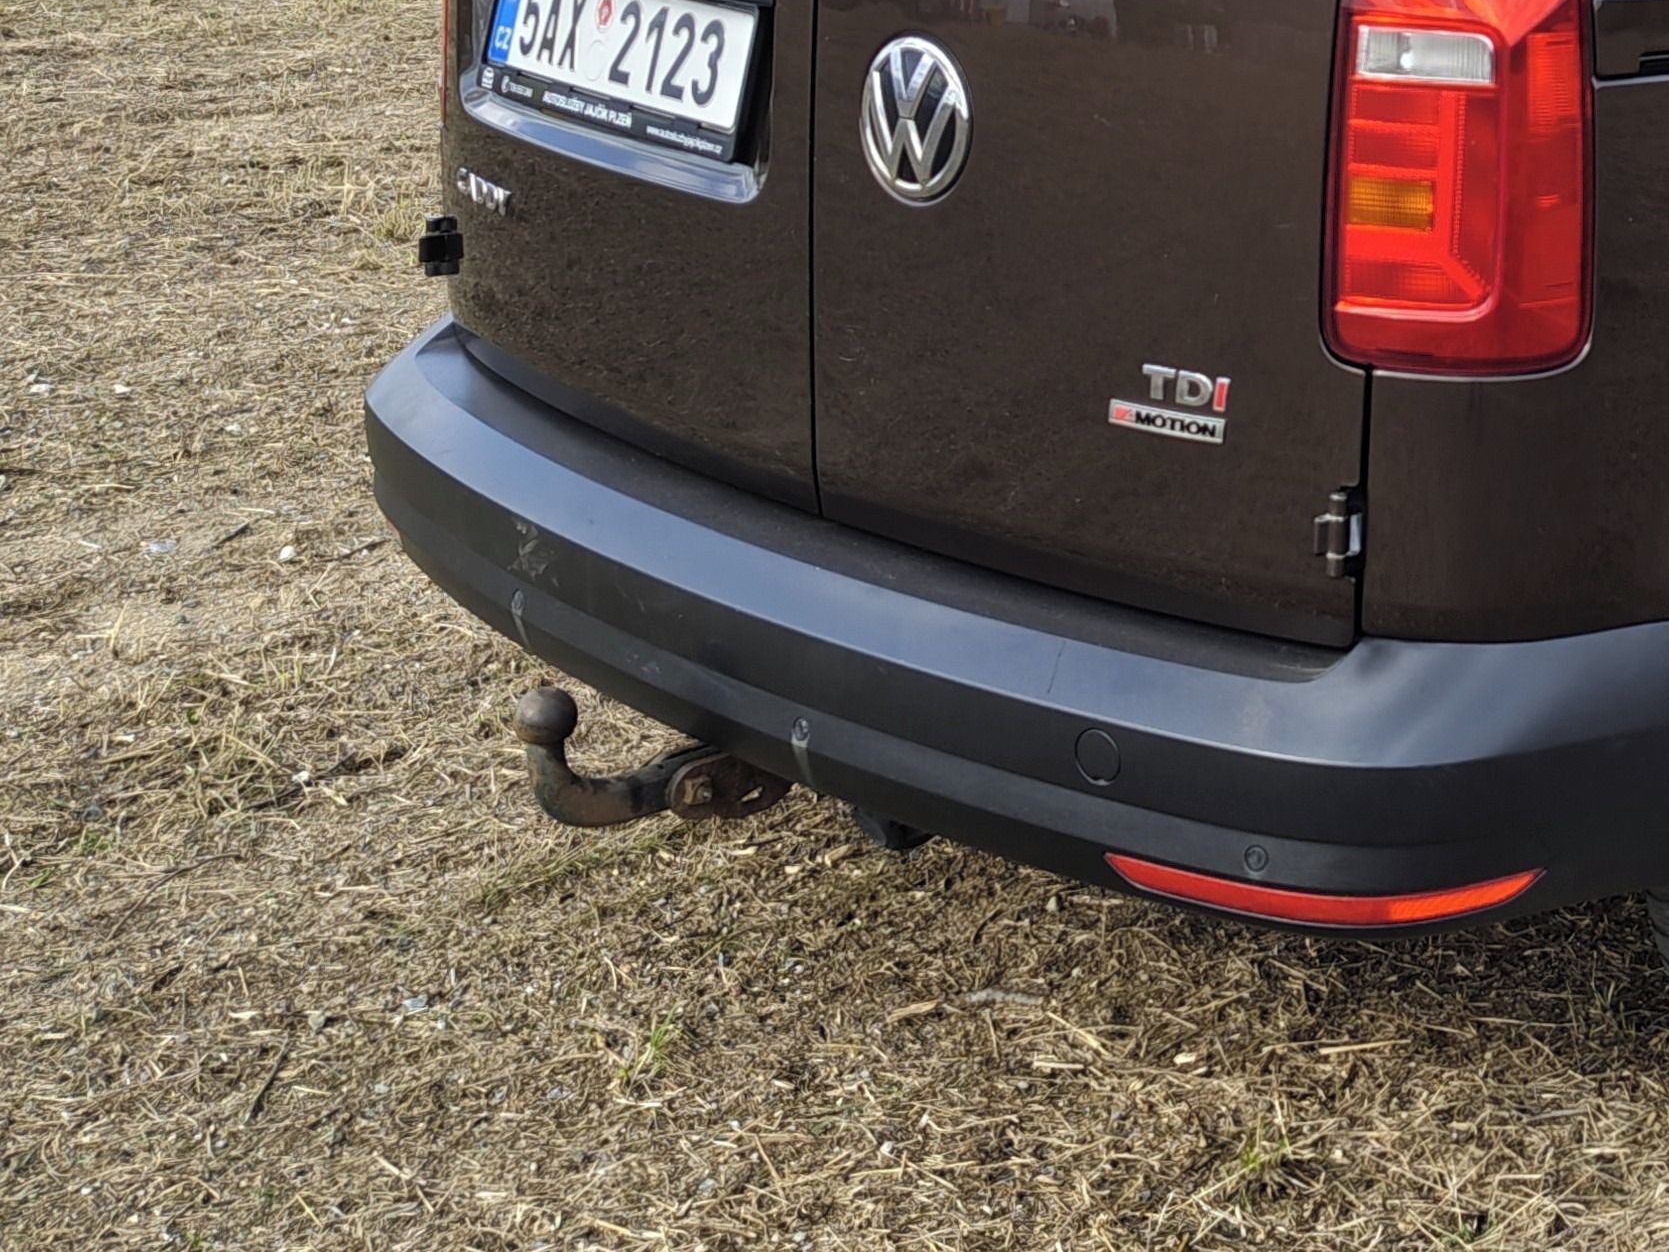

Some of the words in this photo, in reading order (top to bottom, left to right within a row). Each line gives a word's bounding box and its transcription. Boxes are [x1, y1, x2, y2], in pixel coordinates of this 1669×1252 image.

[494, 25, 512, 50] CZ
[608, 0, 727, 106] 2123
[1142, 363, 1231, 412] TDI
